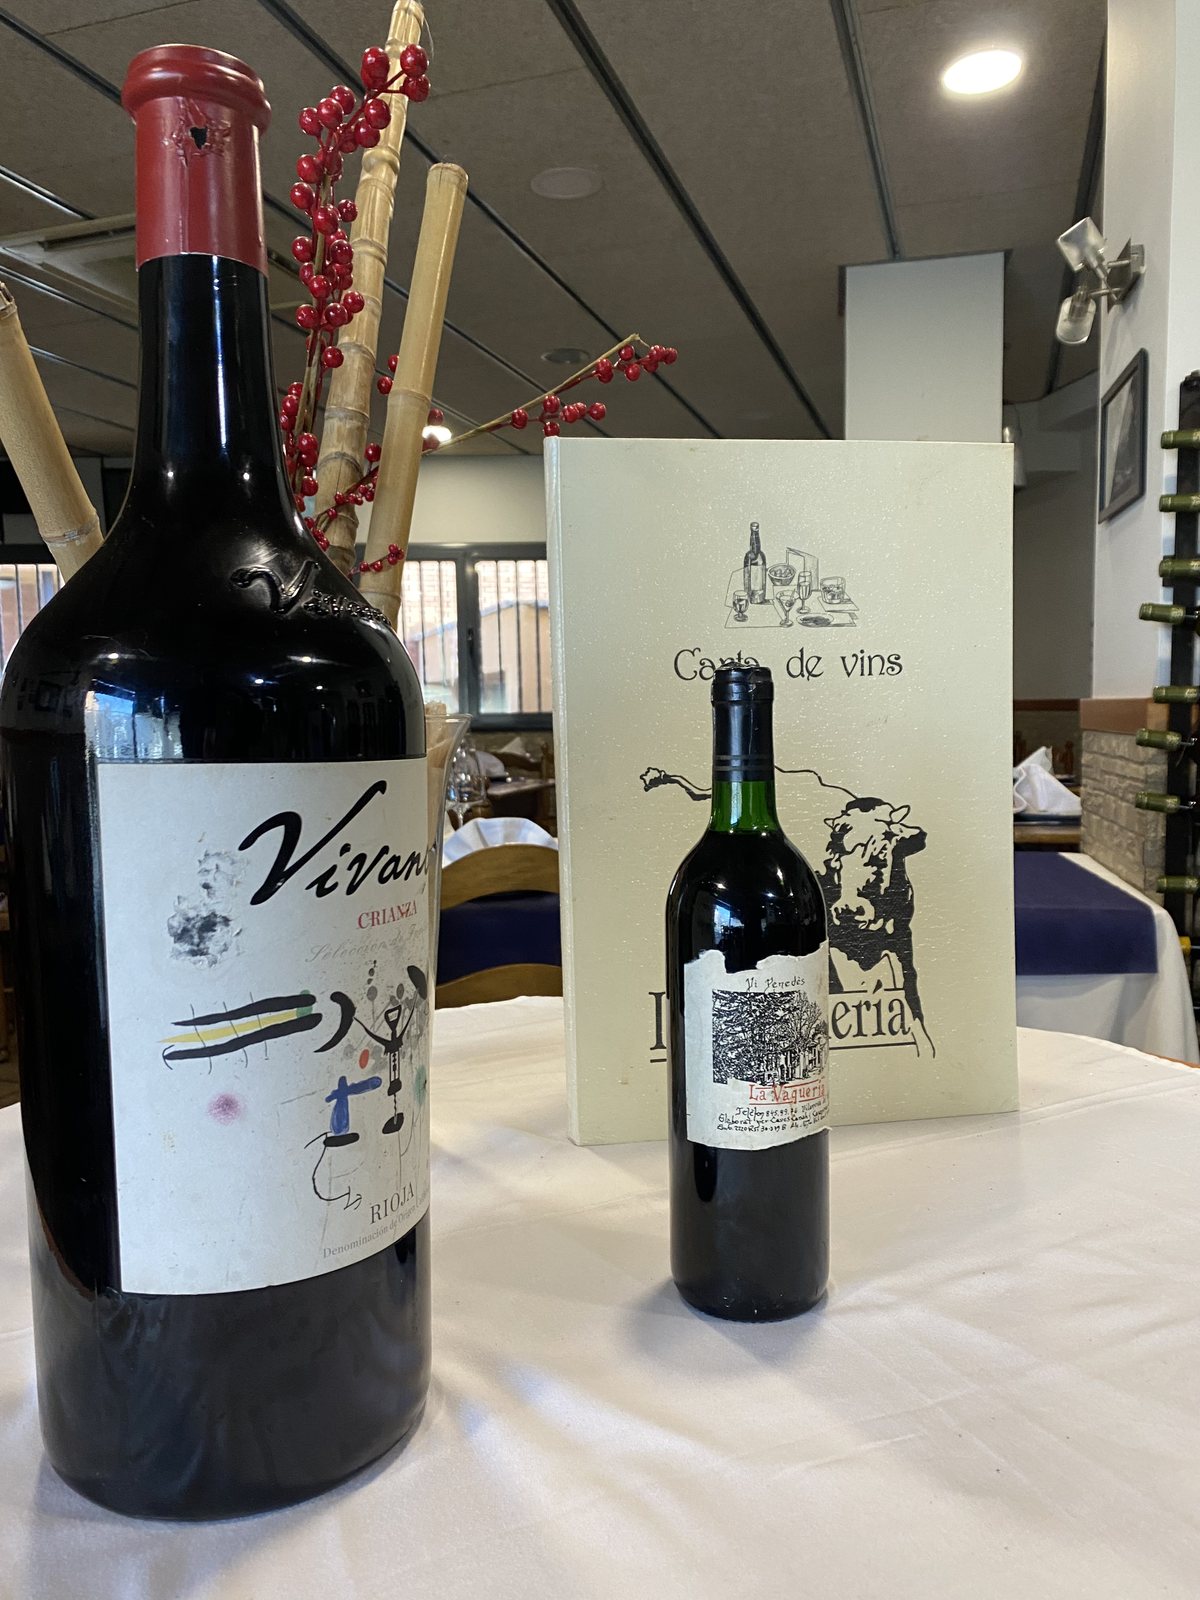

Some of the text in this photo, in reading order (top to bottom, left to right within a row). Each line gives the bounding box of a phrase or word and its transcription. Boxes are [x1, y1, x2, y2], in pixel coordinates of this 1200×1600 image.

[786, 647, 824, 681] de
[841, 649, 904, 678] vins
[357, 900, 417, 930] CRIANZA
[830, 979, 911, 1040] ería
[748, 1084, 767, 1101] La
[370, 1182, 414, 1225] RIOJA
[323, 1224, 388, 1258] Denominación
